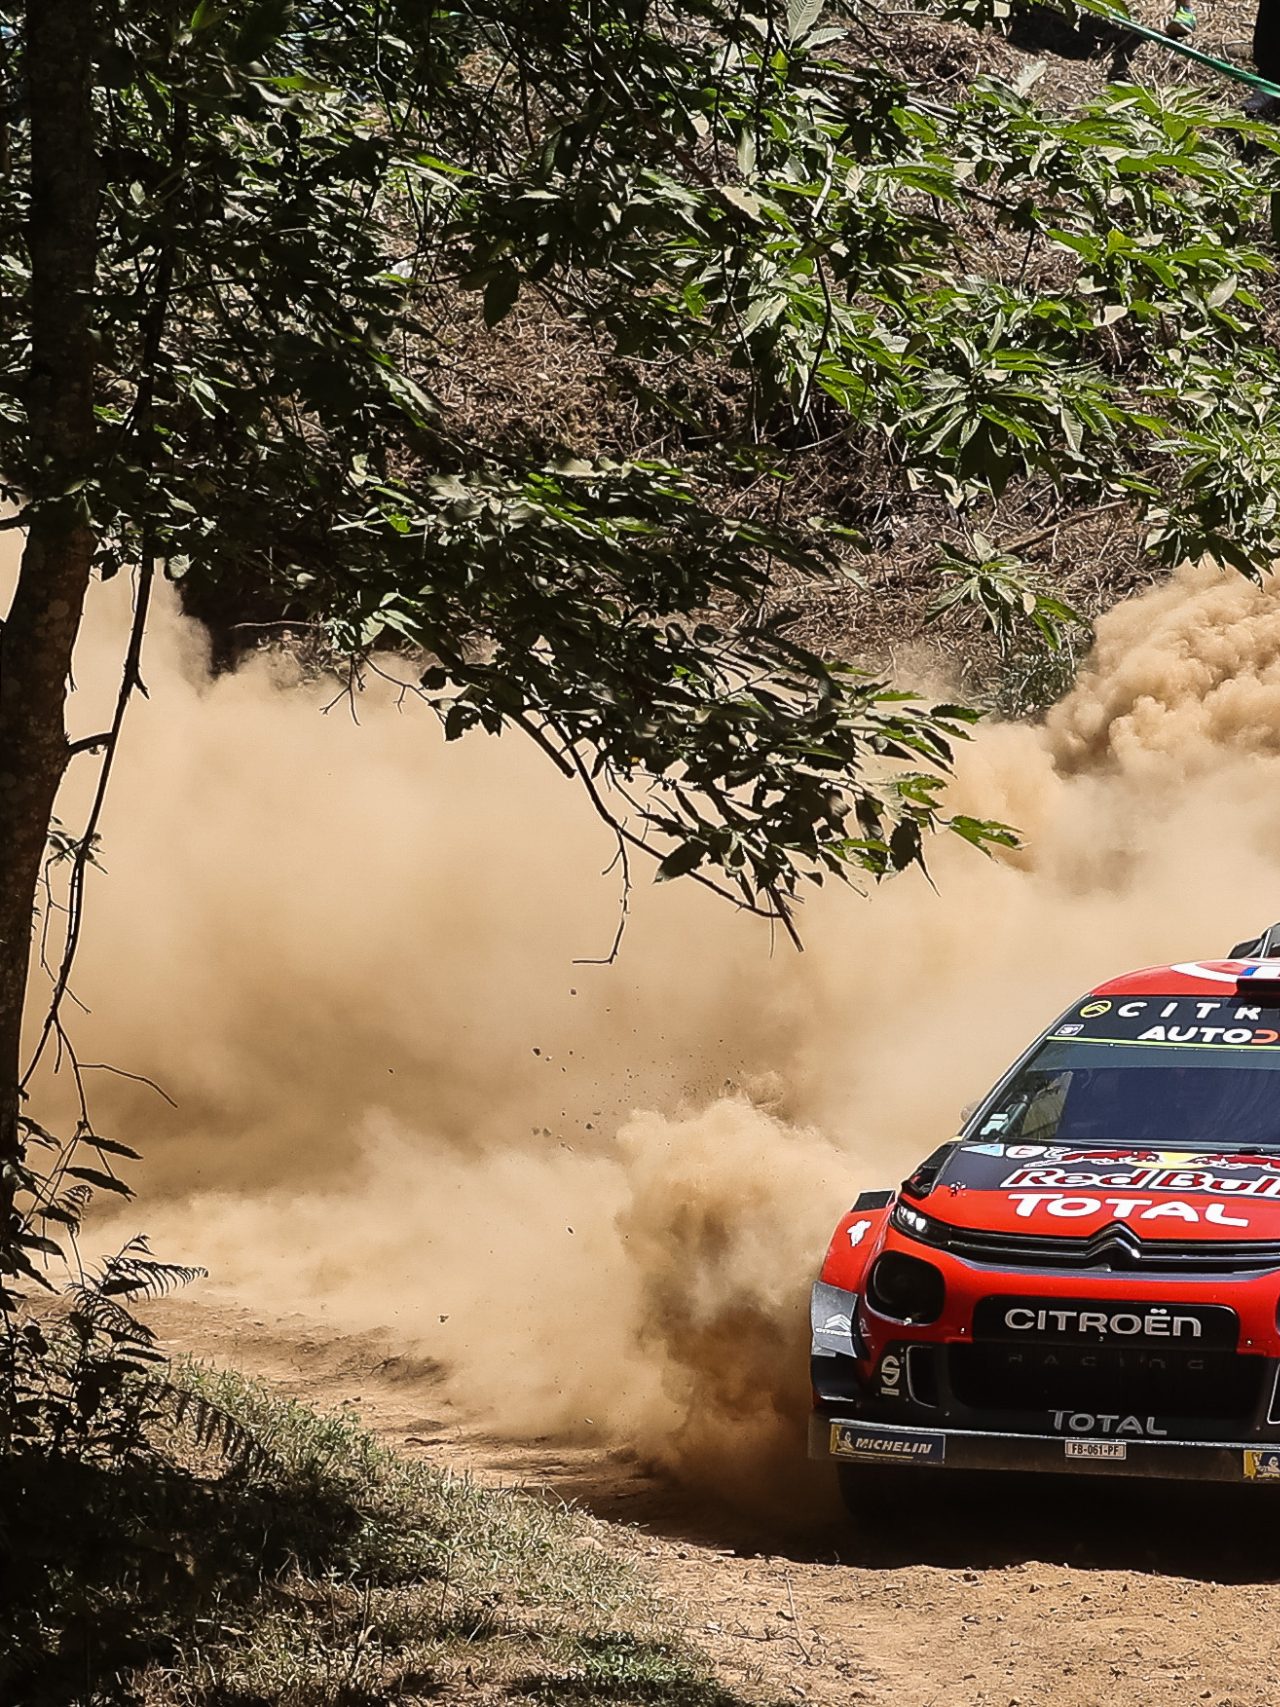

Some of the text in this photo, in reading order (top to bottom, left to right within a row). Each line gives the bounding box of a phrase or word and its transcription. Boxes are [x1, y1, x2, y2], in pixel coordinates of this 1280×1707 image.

[1002, 1169, 1150, 1188] Red
[1007, 1193, 1250, 1227] TOTAL
[1004, 1308, 1202, 1337] CITROËN
[1048, 1409, 1168, 1436] TOTAL
[855, 1437, 933, 1454] MICHELIN
